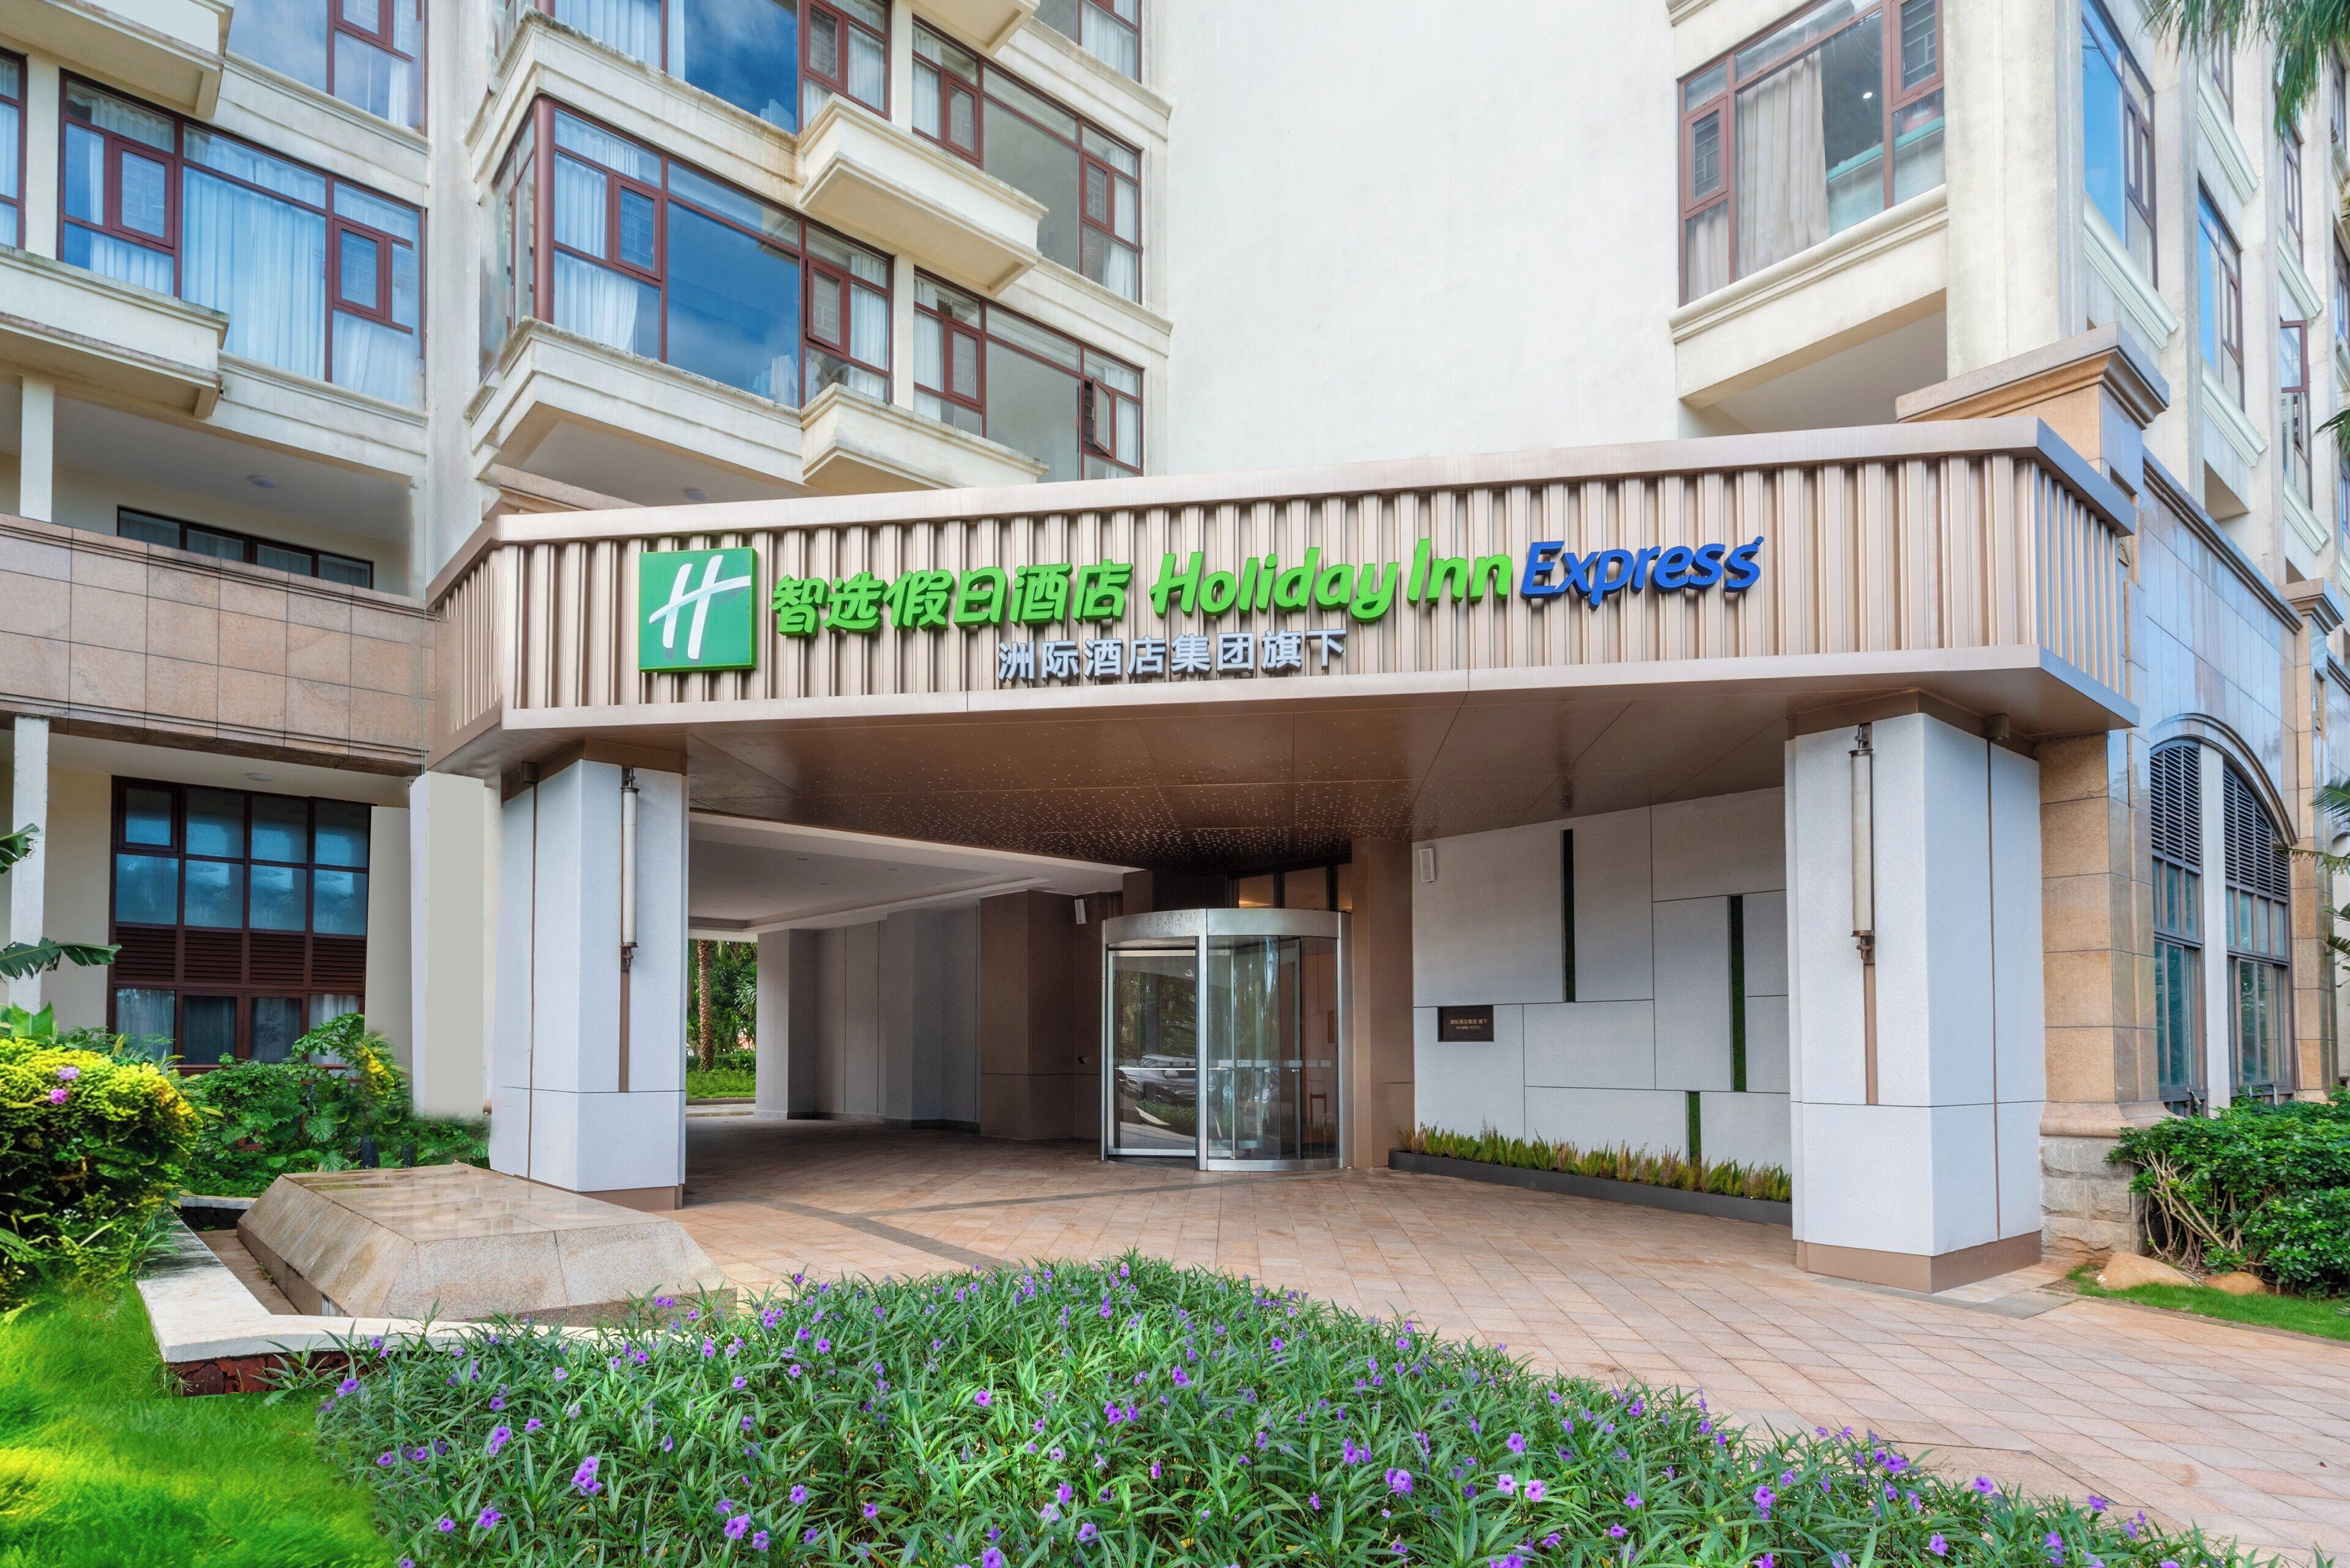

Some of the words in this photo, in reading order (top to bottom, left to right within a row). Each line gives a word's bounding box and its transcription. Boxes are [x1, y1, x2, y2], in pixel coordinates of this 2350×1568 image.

[771, 559, 1132, 635] 智选假日酒店
[1149, 547, 1399, 622] Holiday
[1407, 539, 1513, 603] Inn
[1521, 537, 1762, 607] Express
[998, 629, 1346, 681] 洲际酒店集团旗下
